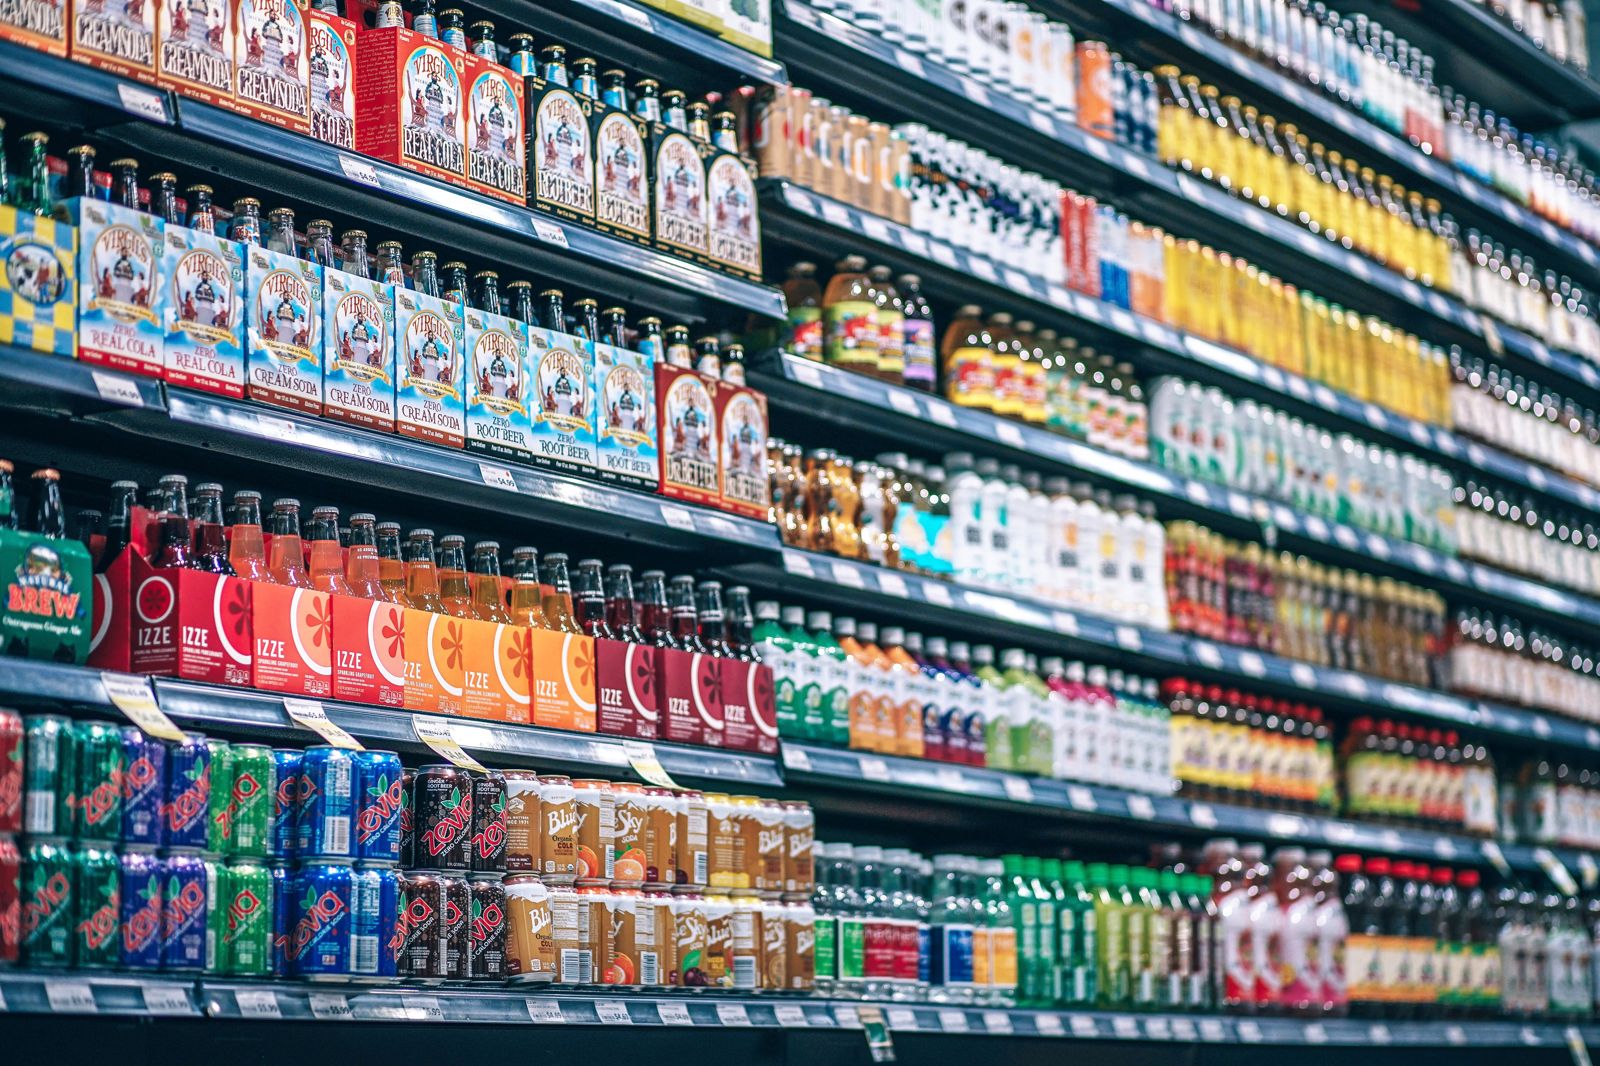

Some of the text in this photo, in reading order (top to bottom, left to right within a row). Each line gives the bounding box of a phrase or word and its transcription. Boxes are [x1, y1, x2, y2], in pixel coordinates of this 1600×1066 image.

[414, 54, 454, 88] VIRGIL'S
[403, 126, 433, 165] REAL
[436, 139, 465, 173] COLA
[469, 151, 524, 195] REAL COLA
[183, 253, 227, 286] VIRGIL'S
[266, 274, 307, 305] VIRGIL'S
[341, 295, 380, 328] VIRGIL'S
[413, 315, 449, 344] VIRGIL'S
[126, 337, 156, 358] COLA
[195, 346, 216, 359] ZERO
[480, 333, 517, 362] VIRGIL'S
[174, 351, 205, 372] REAL
[207, 359, 236, 378] COLA
[278, 364, 298, 376] ZERO
[544, 351, 581, 380] VIRGIL'S
[254, 367, 318, 396] CREAM SODA
[352, 383, 371, 396] ZERO
[330, 388, 390, 414] CREAM SODA
[423, 400, 442, 411] ZERO
[402, 404, 460, 430] CREAM SODA
[493, 416, 510, 427] ZERO
[474, 422, 528, 447] ROOT BEER
[557, 433, 575, 444] ZERO
[540, 440, 592, 464] ROOT BEER
[8, 584, 80, 620] BREW
[44, 619, 69, 636] Ginger
[69, 623, 82, 636] Ale
[138, 626, 171, 646] IZZE
[182, 626, 208, 647] IZZE
[257, 639, 285, 659] IZZE
[337, 650, 362, 670] IZZE
[404, 661, 422, 680] ZZE
[465, 671, 489, 689] IZZE
[536, 680, 558, 697] IZZE
[601, 688, 622, 706] IZZE
[669, 697, 690, 715] IZZE
[725, 704, 746, 722] IZZE
[421, 793, 472, 857] Zevia
[615, 809, 644, 838] Sky
[552, 834, 573, 843] Organic
[621, 834, 639, 844] SODA
[440, 842, 455, 857] ZERO
[274, 890, 345, 962] Zevia
[420, 916, 435, 933] SODA
[451, 919, 465, 935] SODA
[475, 935, 496, 957] CALORIE
